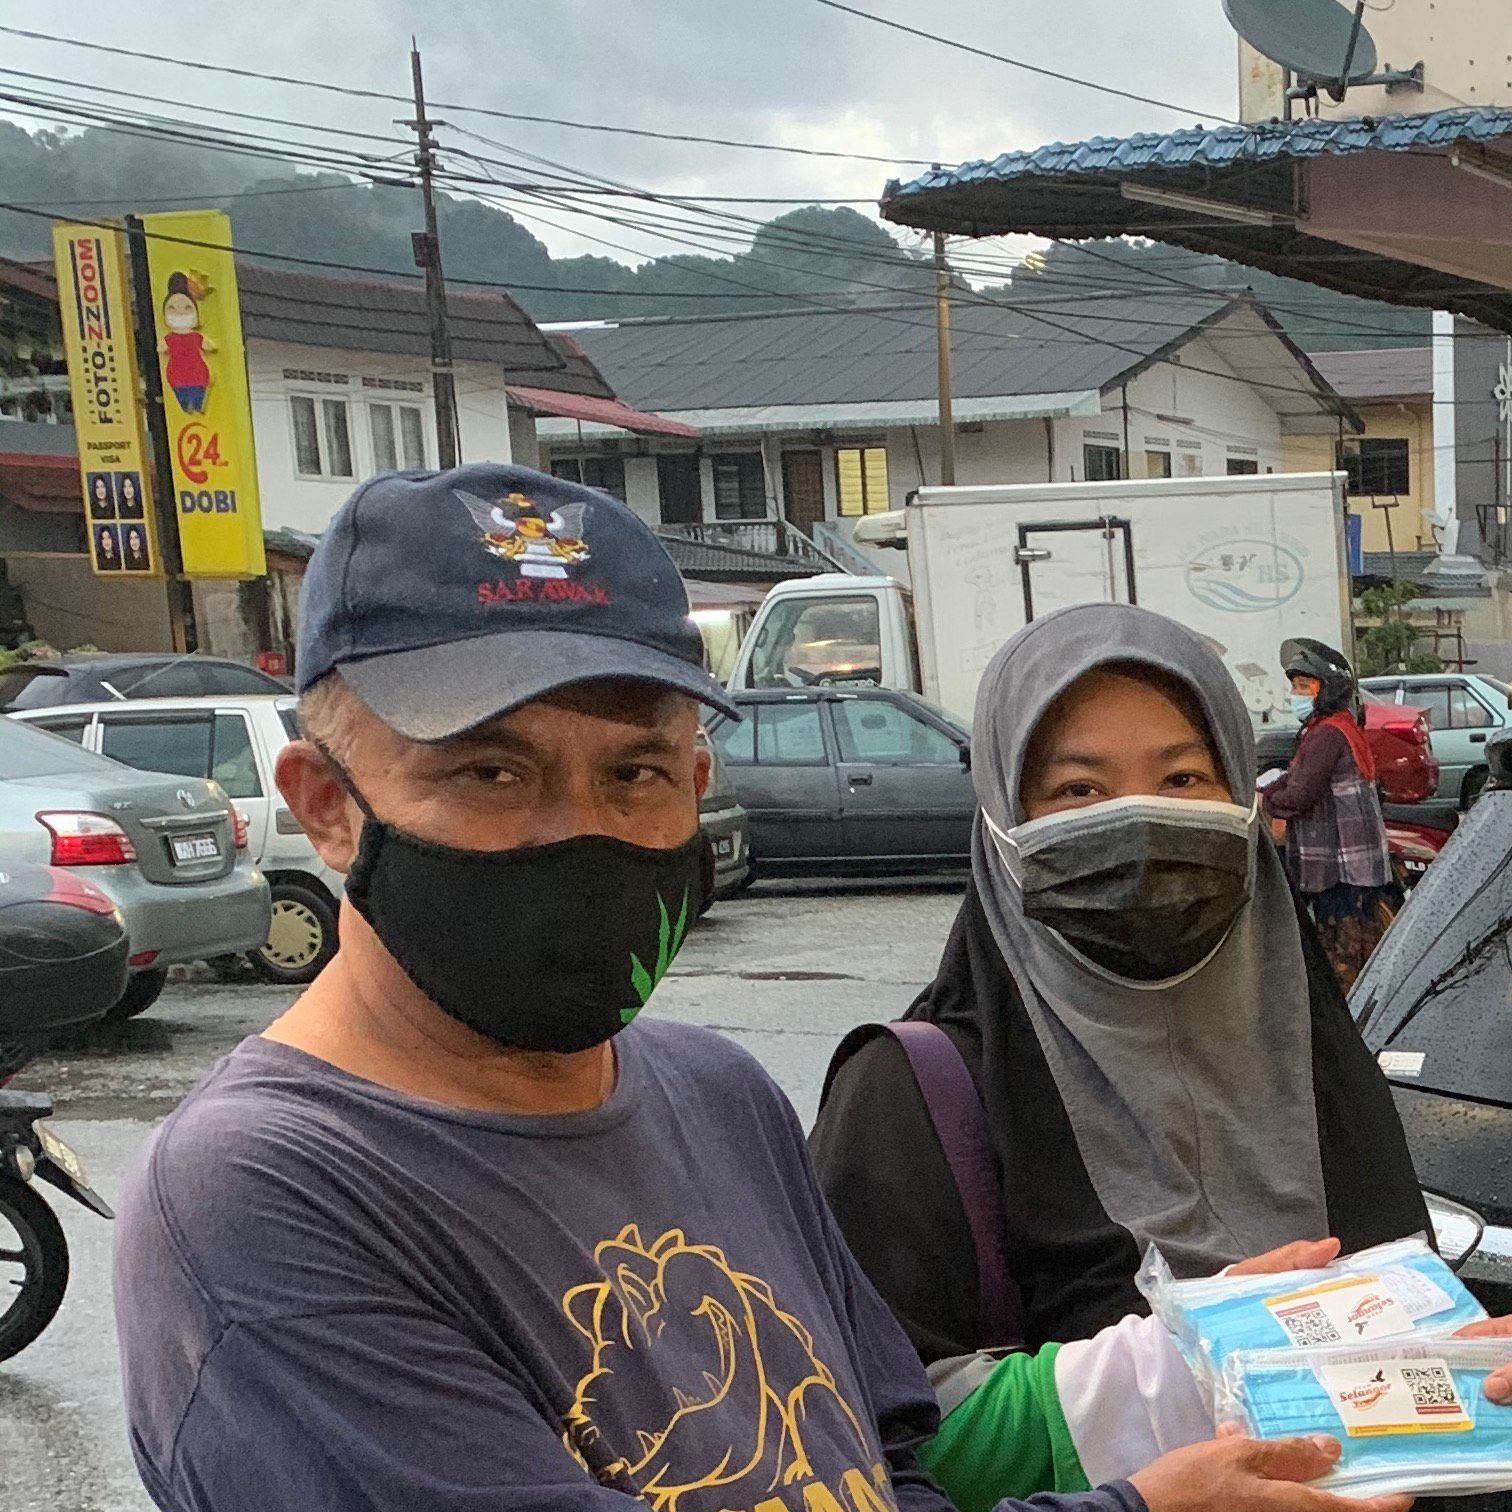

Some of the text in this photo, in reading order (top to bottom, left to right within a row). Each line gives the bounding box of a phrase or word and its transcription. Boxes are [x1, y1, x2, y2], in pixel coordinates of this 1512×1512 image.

[87, 441, 132, 450] PASSPORT
[101, 455, 121, 464] VISA
[180, 490, 237, 513] DOBI
